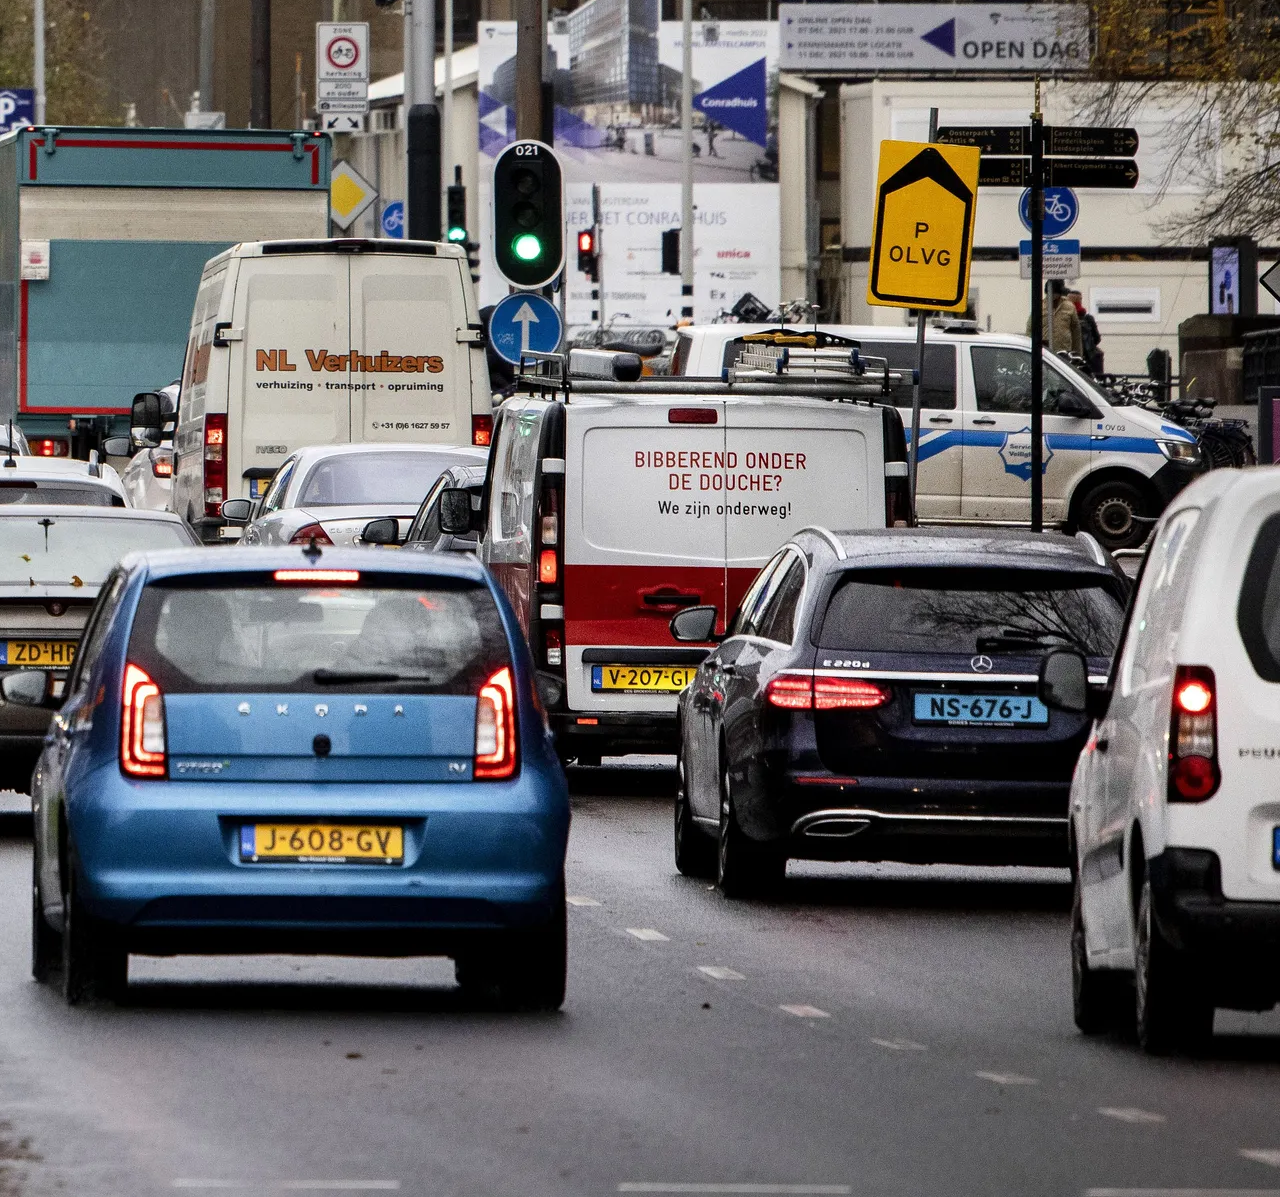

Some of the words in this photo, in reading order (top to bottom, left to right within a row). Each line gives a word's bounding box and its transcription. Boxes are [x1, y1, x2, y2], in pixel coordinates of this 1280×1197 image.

[962, 40, 1024, 60] OPEN
[1032, 41, 1080, 59] DAG
[701, 96, 758, 108] Conradhuis
[515, 146, 538, 156] 021
[626, 212, 727, 226] CONRAHUIS
[915, 222, 929, 238] P
[717, 248, 751, 258] unica
[889, 245, 951, 266] OLVG
[256, 349, 296, 372] NL
[305, 349, 444, 373] Verhuizers
[256, 381, 313, 391] verhuizing
[325, 381, 376, 391] transport
[388, 382, 444, 392] opruiming
[256, 445, 288, 454] IVECO
[635, 451, 738, 468] BIBBEREND
[746, 452, 807, 470] ONDER
[669, 473, 692, 490] DE
[700, 474, 782, 491] DOUCHE?
[658, 500, 679, 515] We
[685, 501, 710, 518] zijn
[716, 502, 792, 519] onderweg!
[15, 643, 78, 662] ZD-HP
[930, 697, 1032, 720] NS-676-J
[264, 828, 390, 854] J-608-GV
